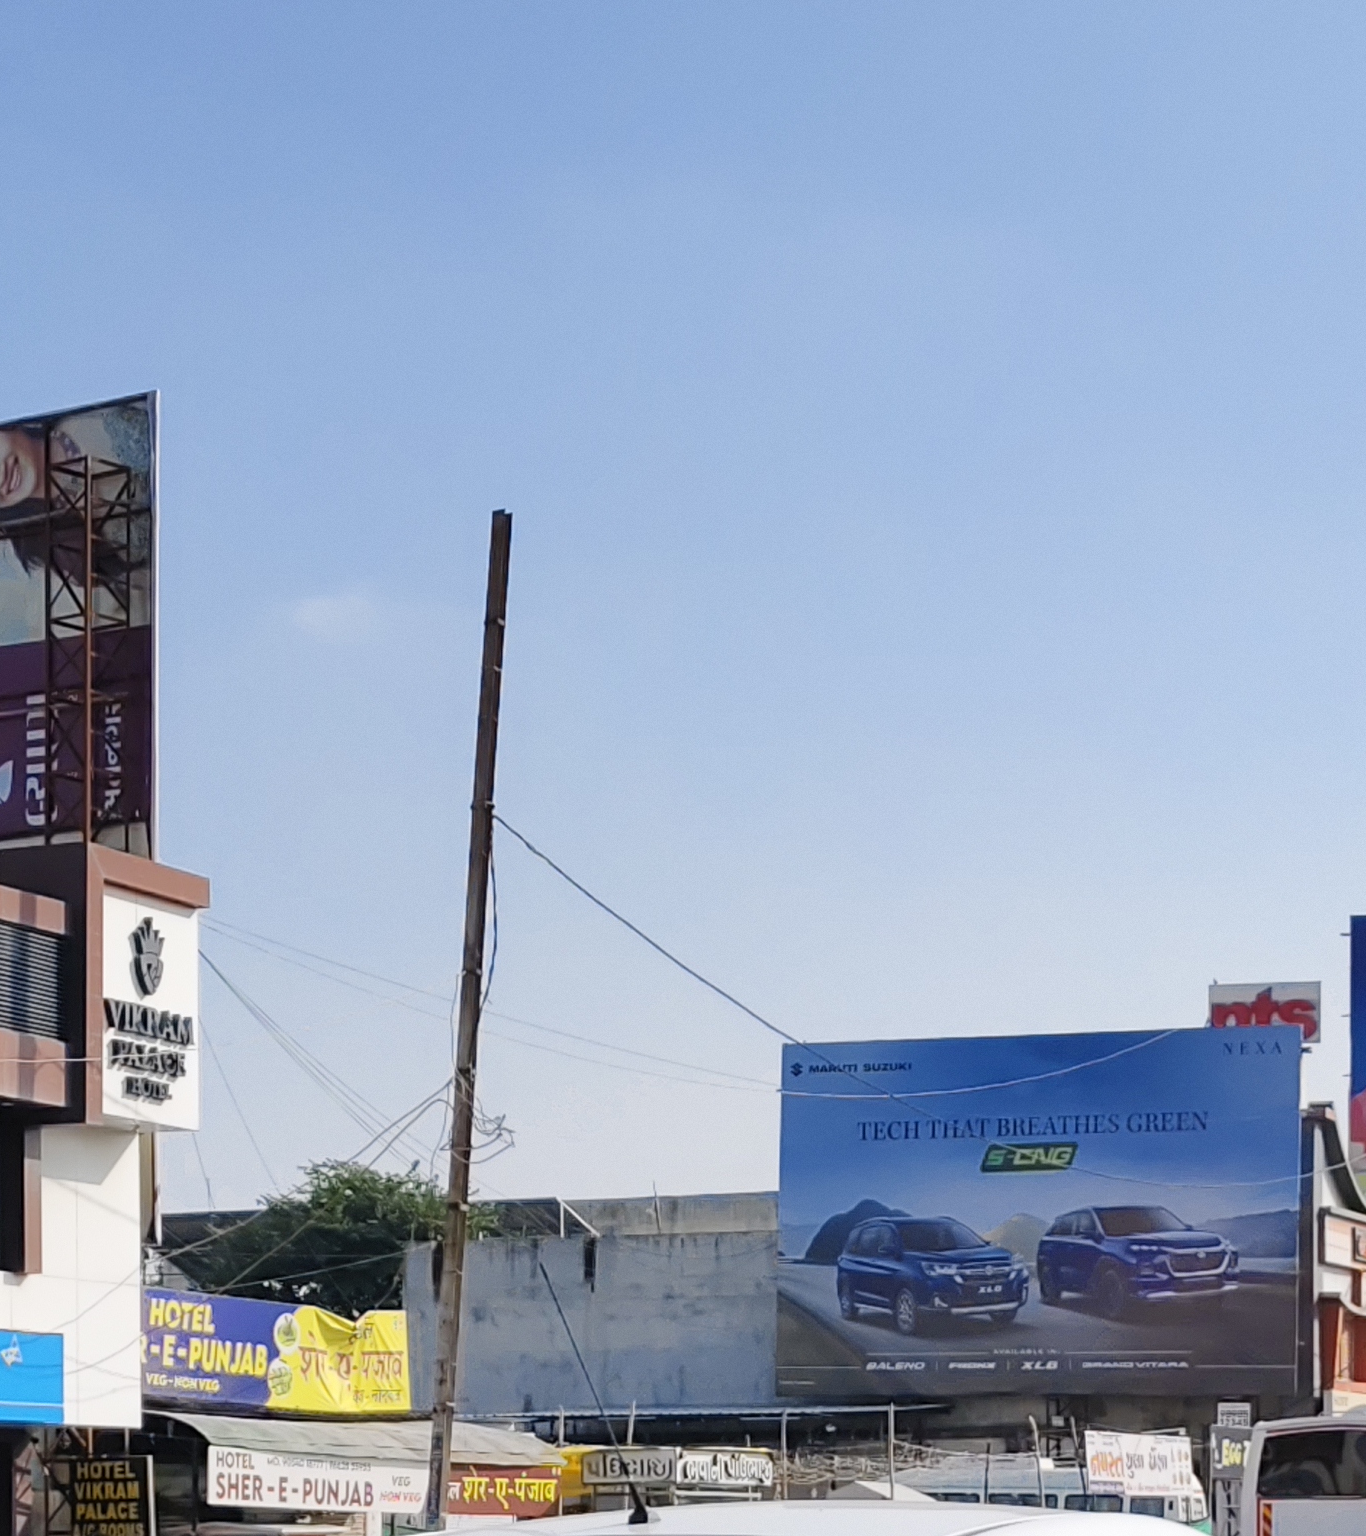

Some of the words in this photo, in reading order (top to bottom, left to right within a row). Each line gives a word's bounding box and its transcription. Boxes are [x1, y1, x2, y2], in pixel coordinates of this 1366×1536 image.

[103, 998, 195, 1046] VIKRAM
[808, 1064, 857, 1074] MARUTI
[863, 1062, 913, 1072] SUZUKI
[857, 1121, 920, 1141] TECH
[926, 1118, 991, 1139] THAT
[995, 1114, 1120, 1137] BREATHES
[1125, 1111, 1209, 1133] GREEN
[149, 1297, 216, 1336] HOTEL
[76, 1461, 136, 1479] HOTEL
[216, 1450, 255, 1470] HOTEL
[74, 1481, 140, 1501] VIKRAM
[392, 1475, 411, 1487] VEG
[76, 1502, 139, 1520] PALACE
